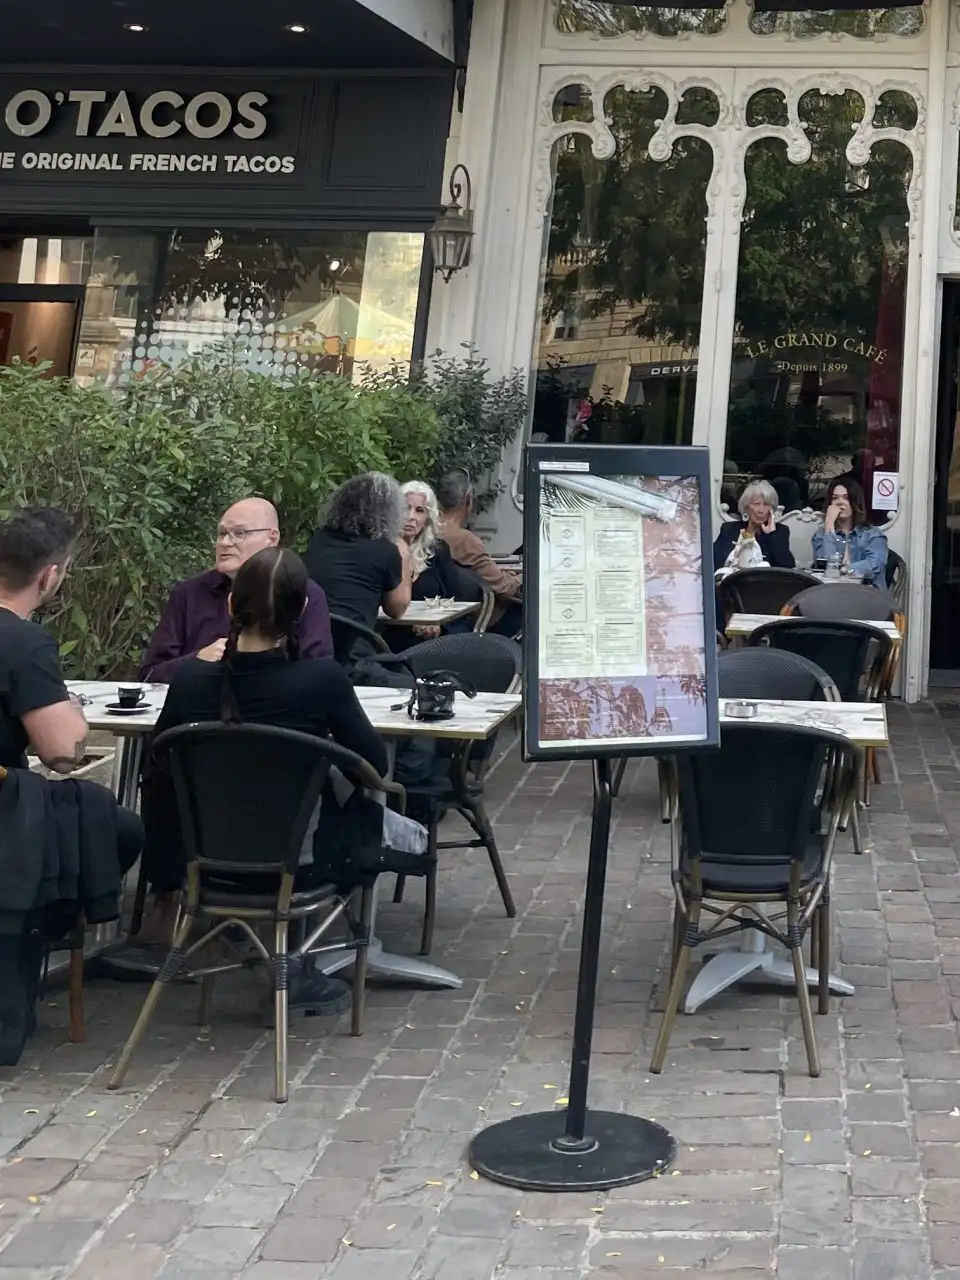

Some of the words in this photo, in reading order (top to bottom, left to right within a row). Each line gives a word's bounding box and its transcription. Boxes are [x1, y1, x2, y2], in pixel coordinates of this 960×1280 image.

[0, 152, 16, 169] E
[21, 152, 123, 171] ORIGINAL
[129, 153, 218, 172] FRENCH
[224, 155, 295, 174] TACOS
[745, 339, 769, 359] LE
[774, 333, 837, 349] GRAND
[843, 338, 888, 365] CAFÉ
[782, 361, 818, 374] Depuis
[821, 362, 848, 373] 1899
